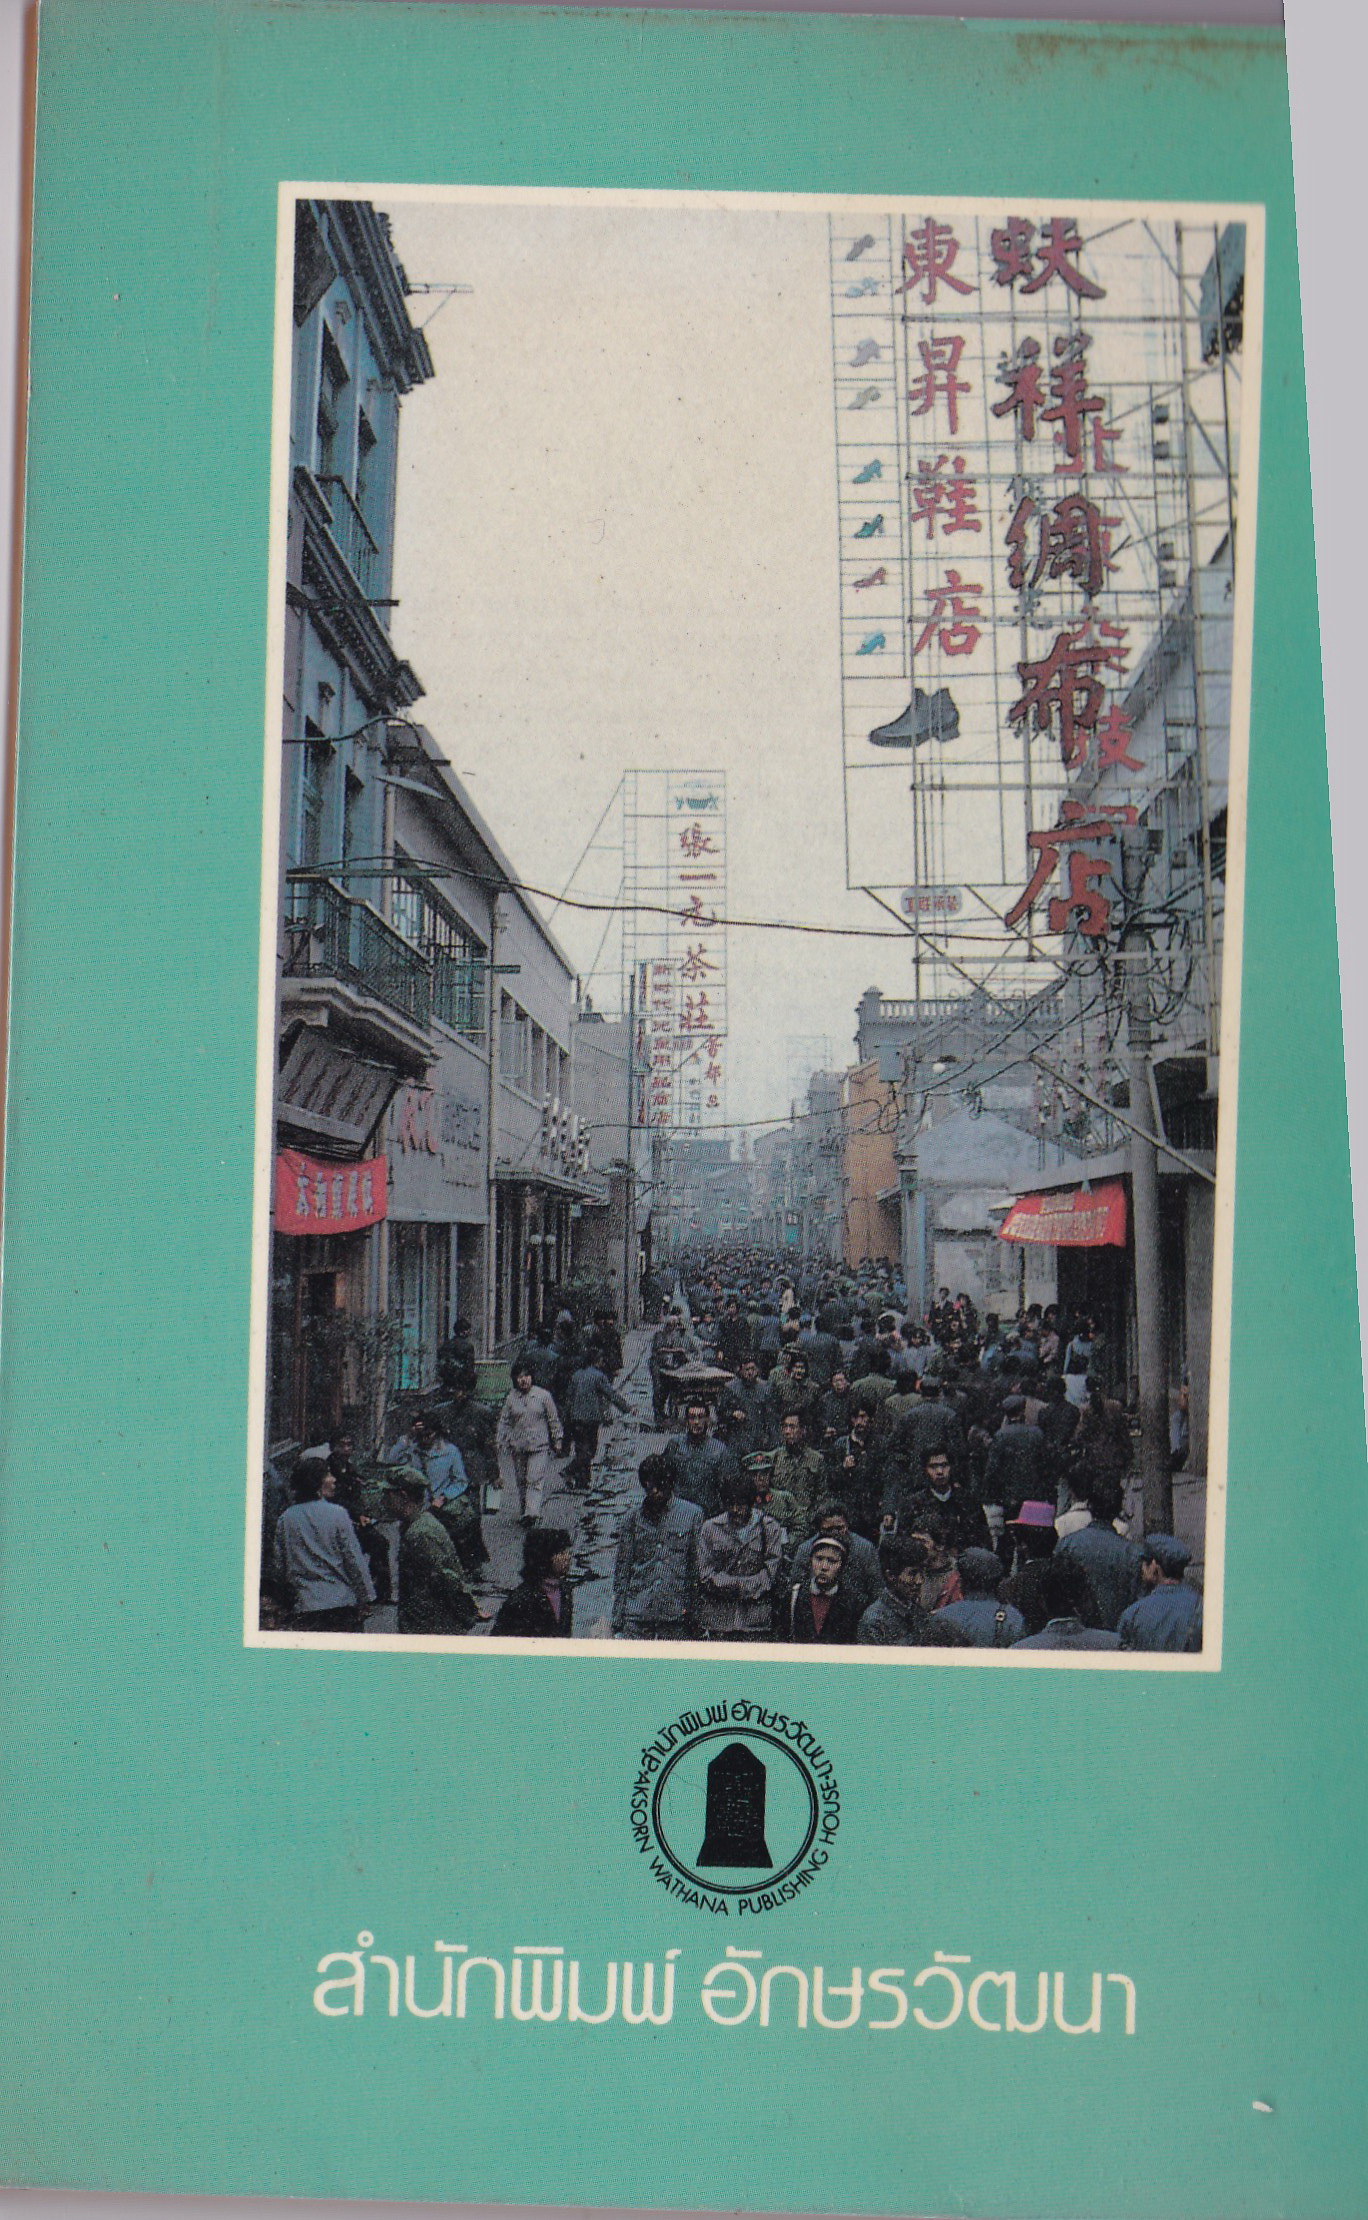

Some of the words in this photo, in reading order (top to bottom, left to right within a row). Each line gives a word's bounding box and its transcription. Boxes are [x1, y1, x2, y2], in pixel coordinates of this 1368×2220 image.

[895, 217, 983, 656] 東昇鞋店
[641, 1700, 727, 1772] สำนักพิมพ์
[731, 1700, 833, 1777] อักษรวัฒนา
[630, 1770, 654, 1854] AKSORN
[650, 1855, 728, 1916] WATHANA
[739, 1849, 828, 1916] PUBLISHING
[819, 1780, 840, 1845] HOUSE
[313, 1930, 682, 2025] สำนักพิมพ์
[701, 1946, 1136, 2035] อักษรวัฒนา
